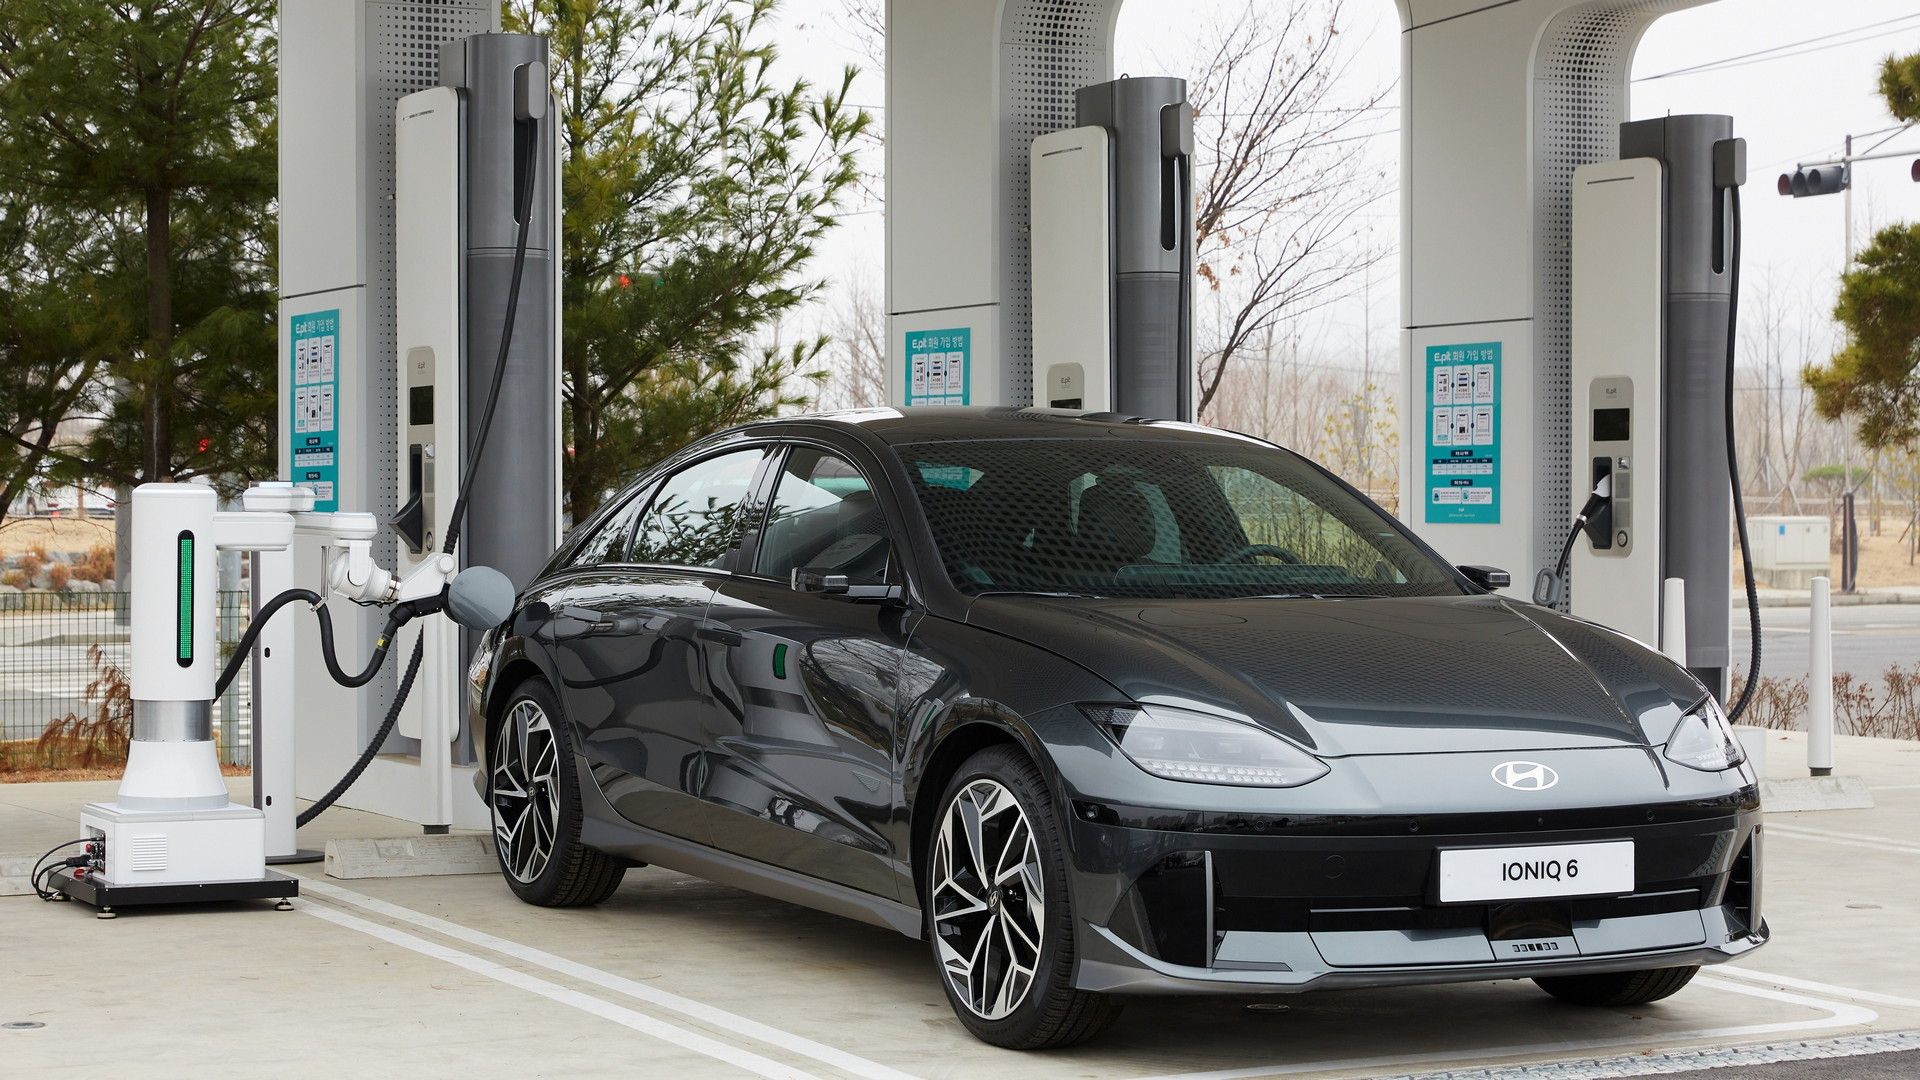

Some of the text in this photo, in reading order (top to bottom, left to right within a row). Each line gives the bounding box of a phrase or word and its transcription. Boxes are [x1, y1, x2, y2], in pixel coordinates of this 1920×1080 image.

[928, 336, 939, 349] 회원
[940, 336, 951, 348] 가입
[952, 335, 963, 348] 방법
[1452, 350, 1465, 362] 회원
[1466, 349, 1479, 361] 가입
[1480, 348, 1494, 361] 방법
[1502, 859, 1579, 882] IONIQ 6
